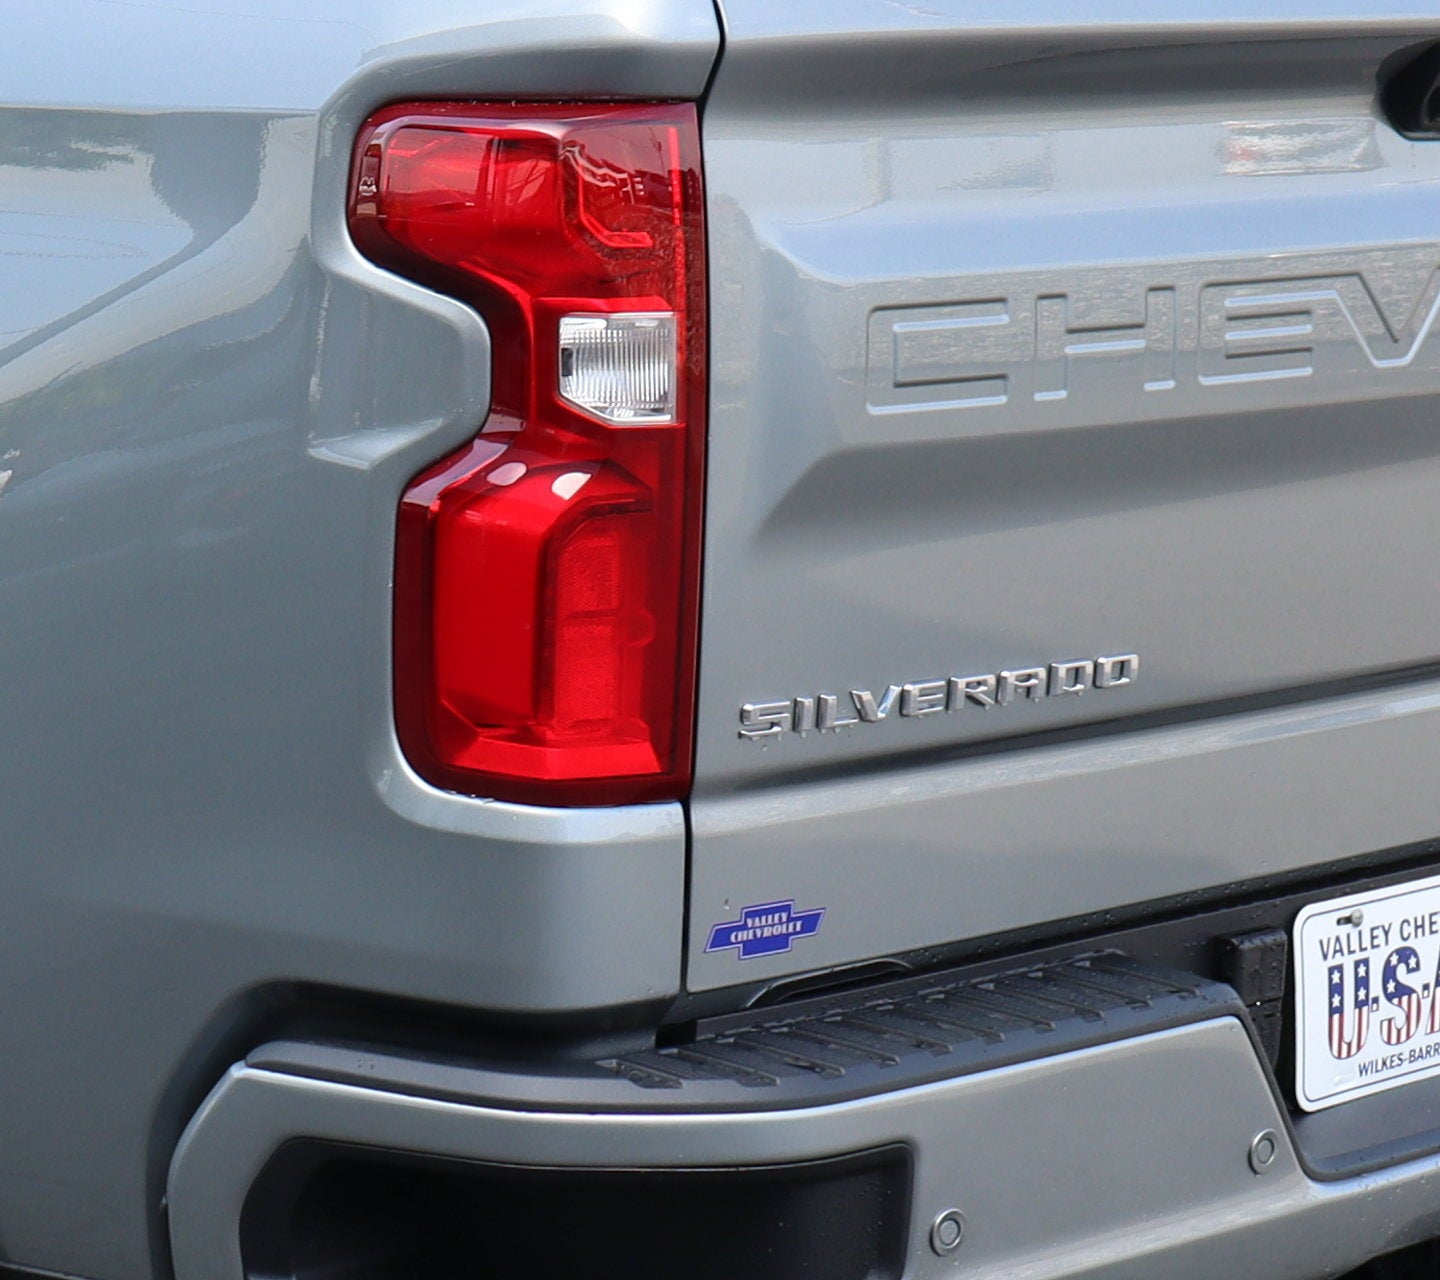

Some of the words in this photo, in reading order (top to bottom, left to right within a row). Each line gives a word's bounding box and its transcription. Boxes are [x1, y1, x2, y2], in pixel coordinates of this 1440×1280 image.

[739, 652, 1139, 740] SILVERADO
[730, 920, 802, 943] CHEVROLET
[746, 911, 789, 928] VALLEY
[1319, 922, 1393, 961] VALLEY
